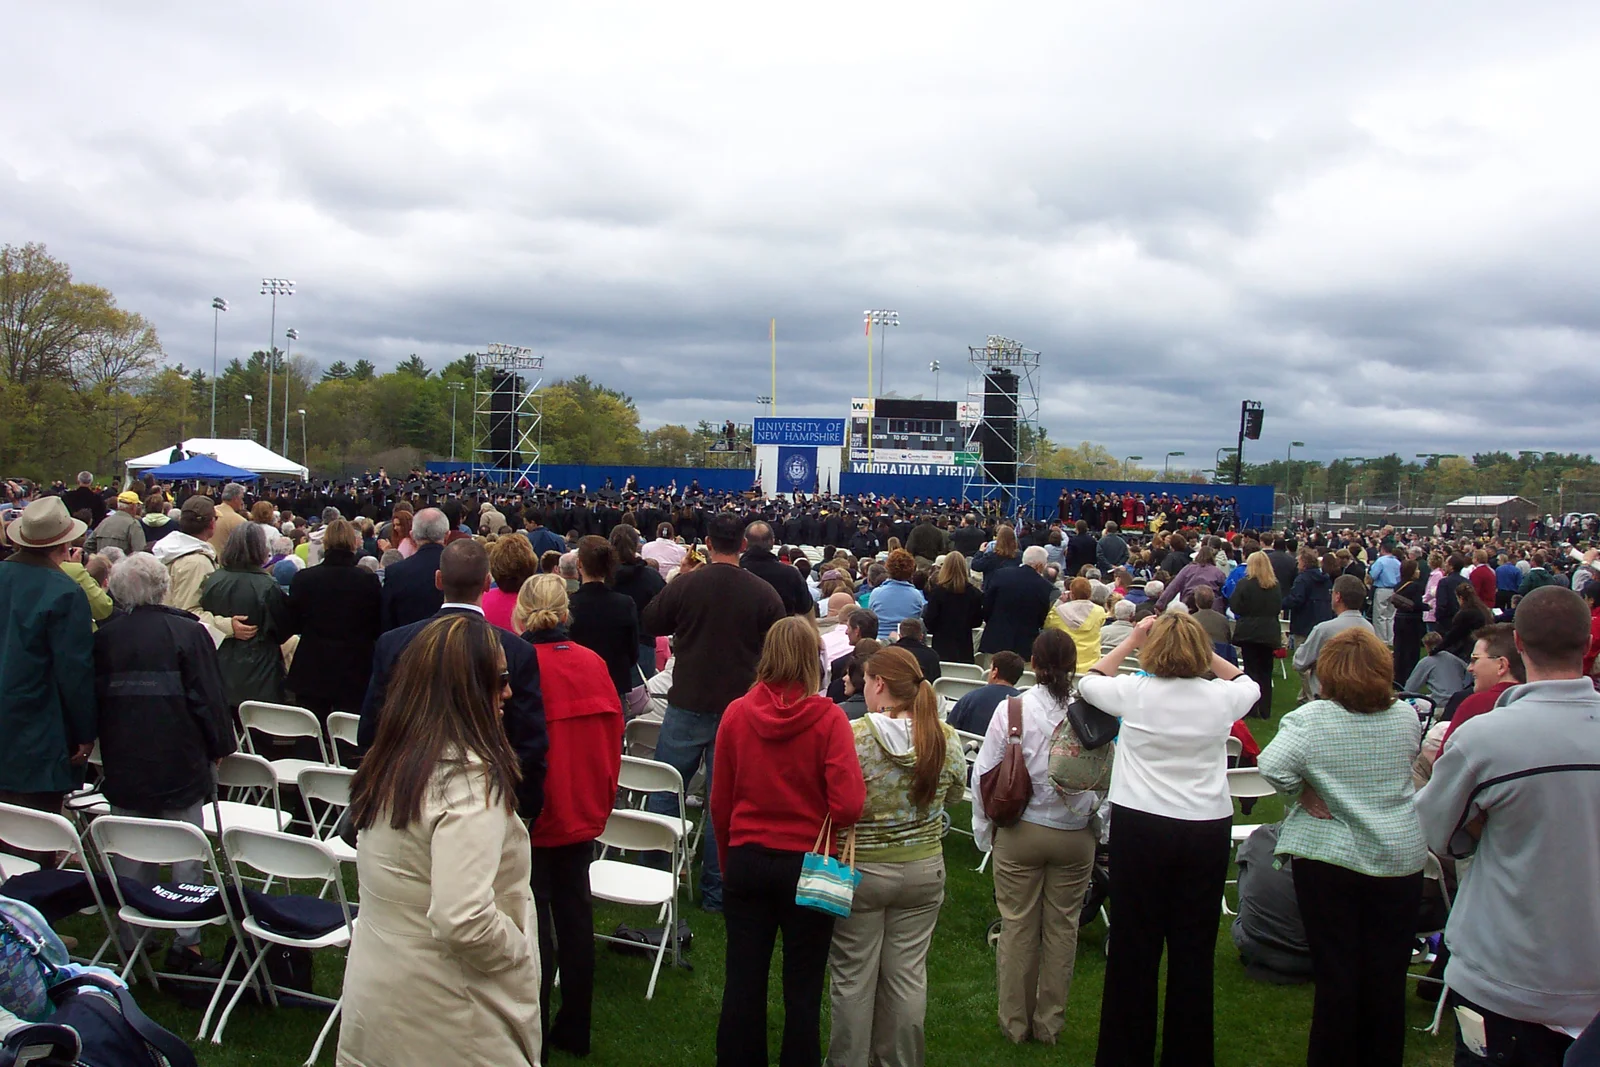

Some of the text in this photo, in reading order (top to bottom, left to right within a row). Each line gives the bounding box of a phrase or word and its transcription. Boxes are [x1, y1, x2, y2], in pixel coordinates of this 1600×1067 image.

[757, 422, 842, 432] UNIVERSITY OF
[757, 431, 840, 442] NEW HAMPSHIRE
[853, 462, 975, 477] MOORADIAN FIELD
[152, 885, 183, 901] NEW
